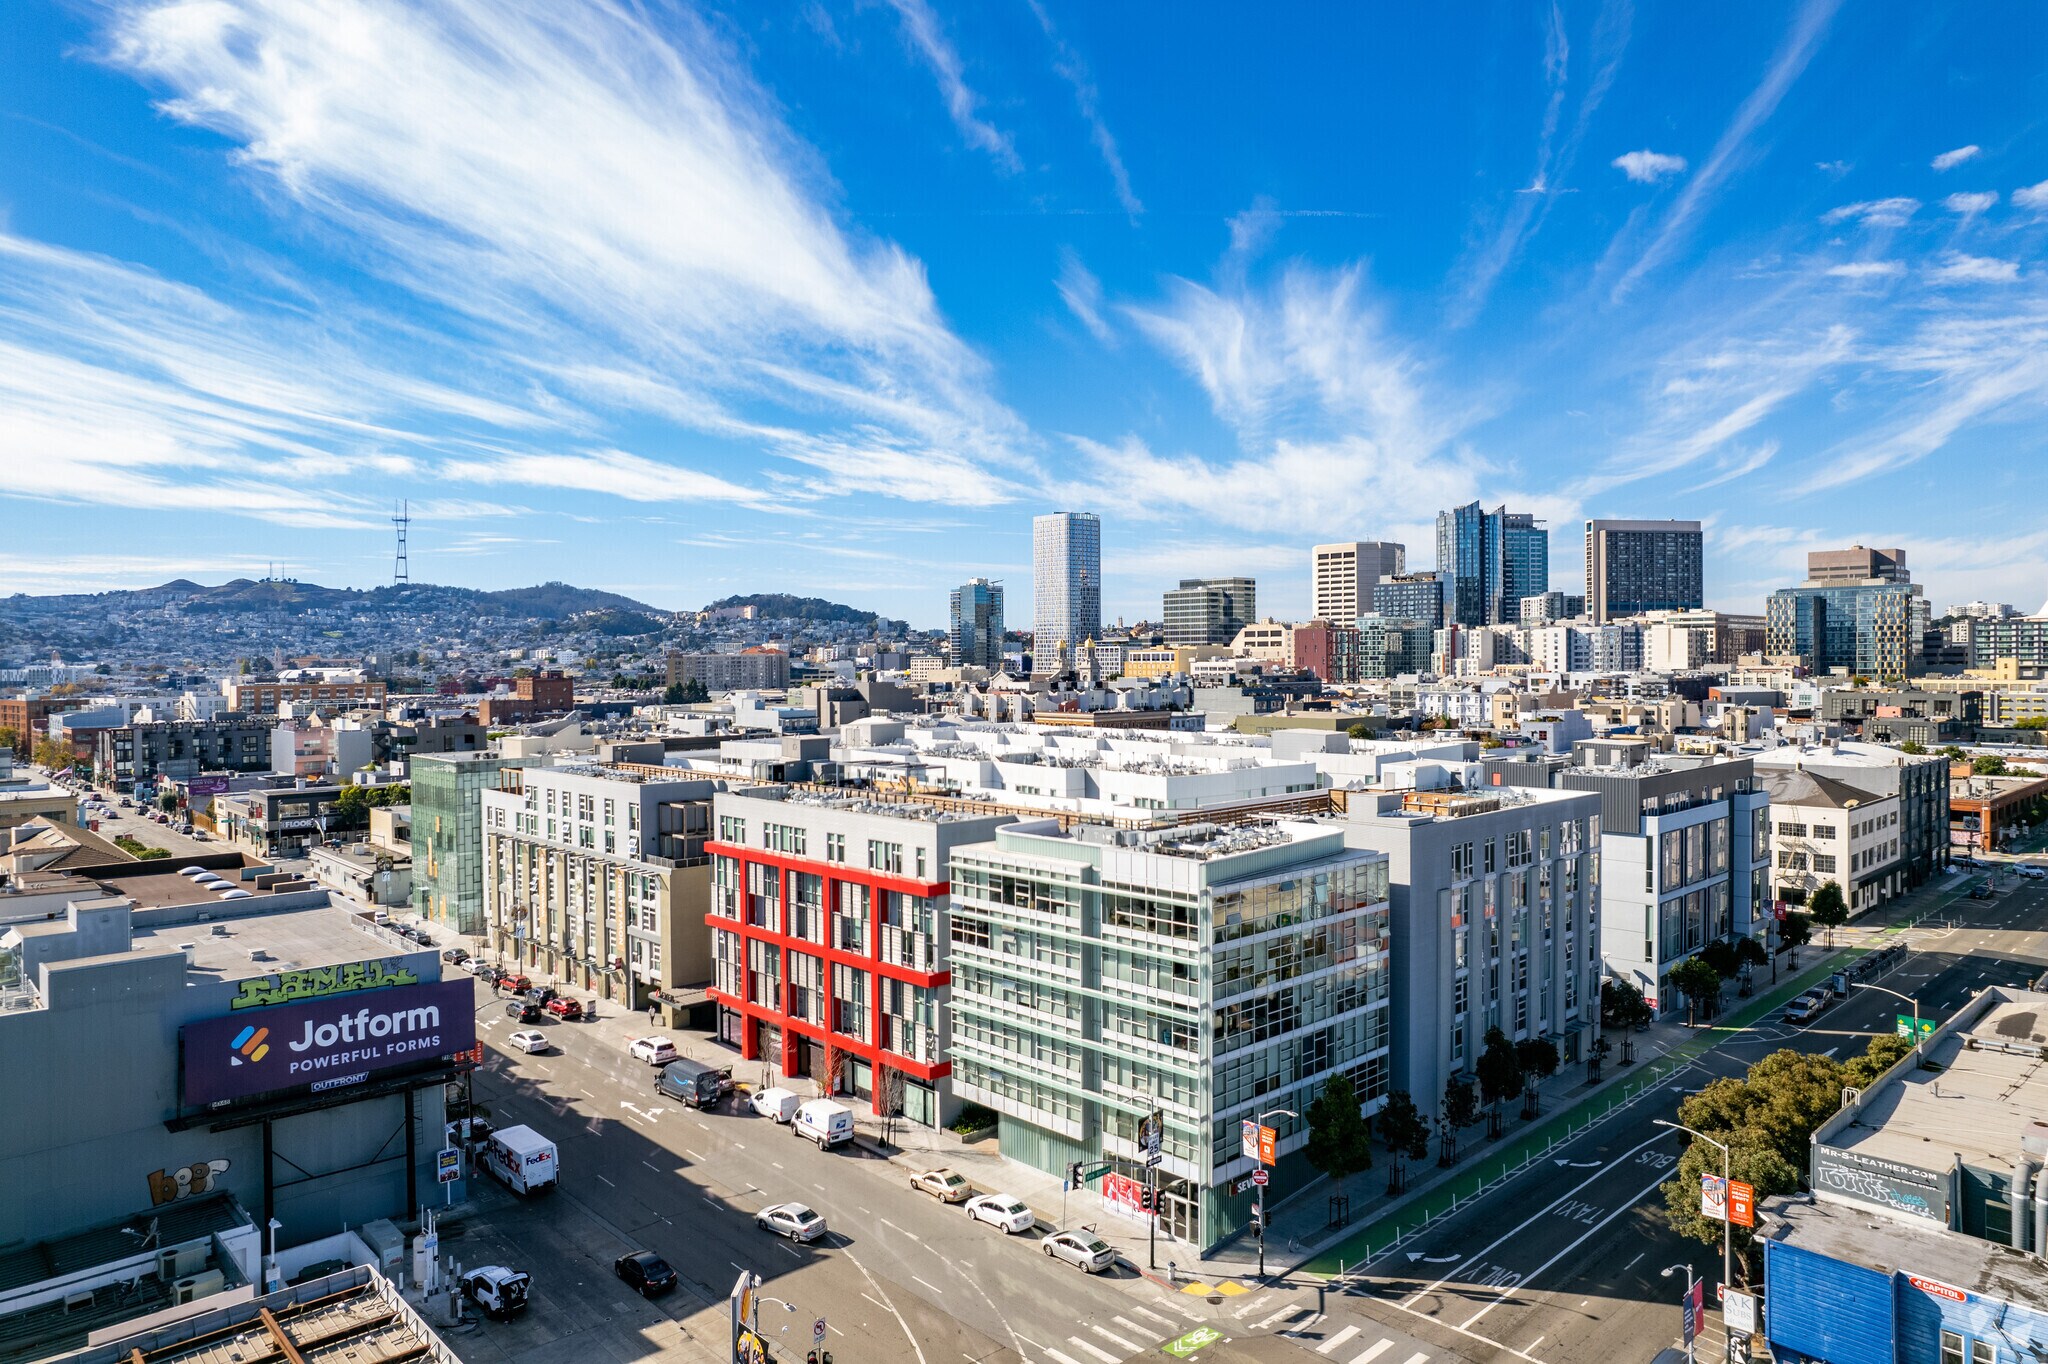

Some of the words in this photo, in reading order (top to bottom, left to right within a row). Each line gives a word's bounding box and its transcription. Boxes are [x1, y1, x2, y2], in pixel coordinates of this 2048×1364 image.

[285, 820, 312, 828] FLOOR
[289, 1005, 440, 1052] Jotform
[290, 1047, 381, 1074] POWERFUL
[387, 1035, 441, 1055] FORMS
[313, 1073, 367, 1091] OUTFRONT
[1149, 1144, 1159, 1154] 25
[526, 1152, 551, 1166] FedEx
[1635, 1150, 1676, 1169] BUS
[1820, 1146, 1938, 1181] MR-S-LEATHER.COM
[1553, 1200, 1605, 1224] TAXI
[1458, 1262, 1522, 1291] ONLY
[1922, 1282, 1961, 1300] CAPITOL
[1725, 1304, 1752, 1321] SUBS
